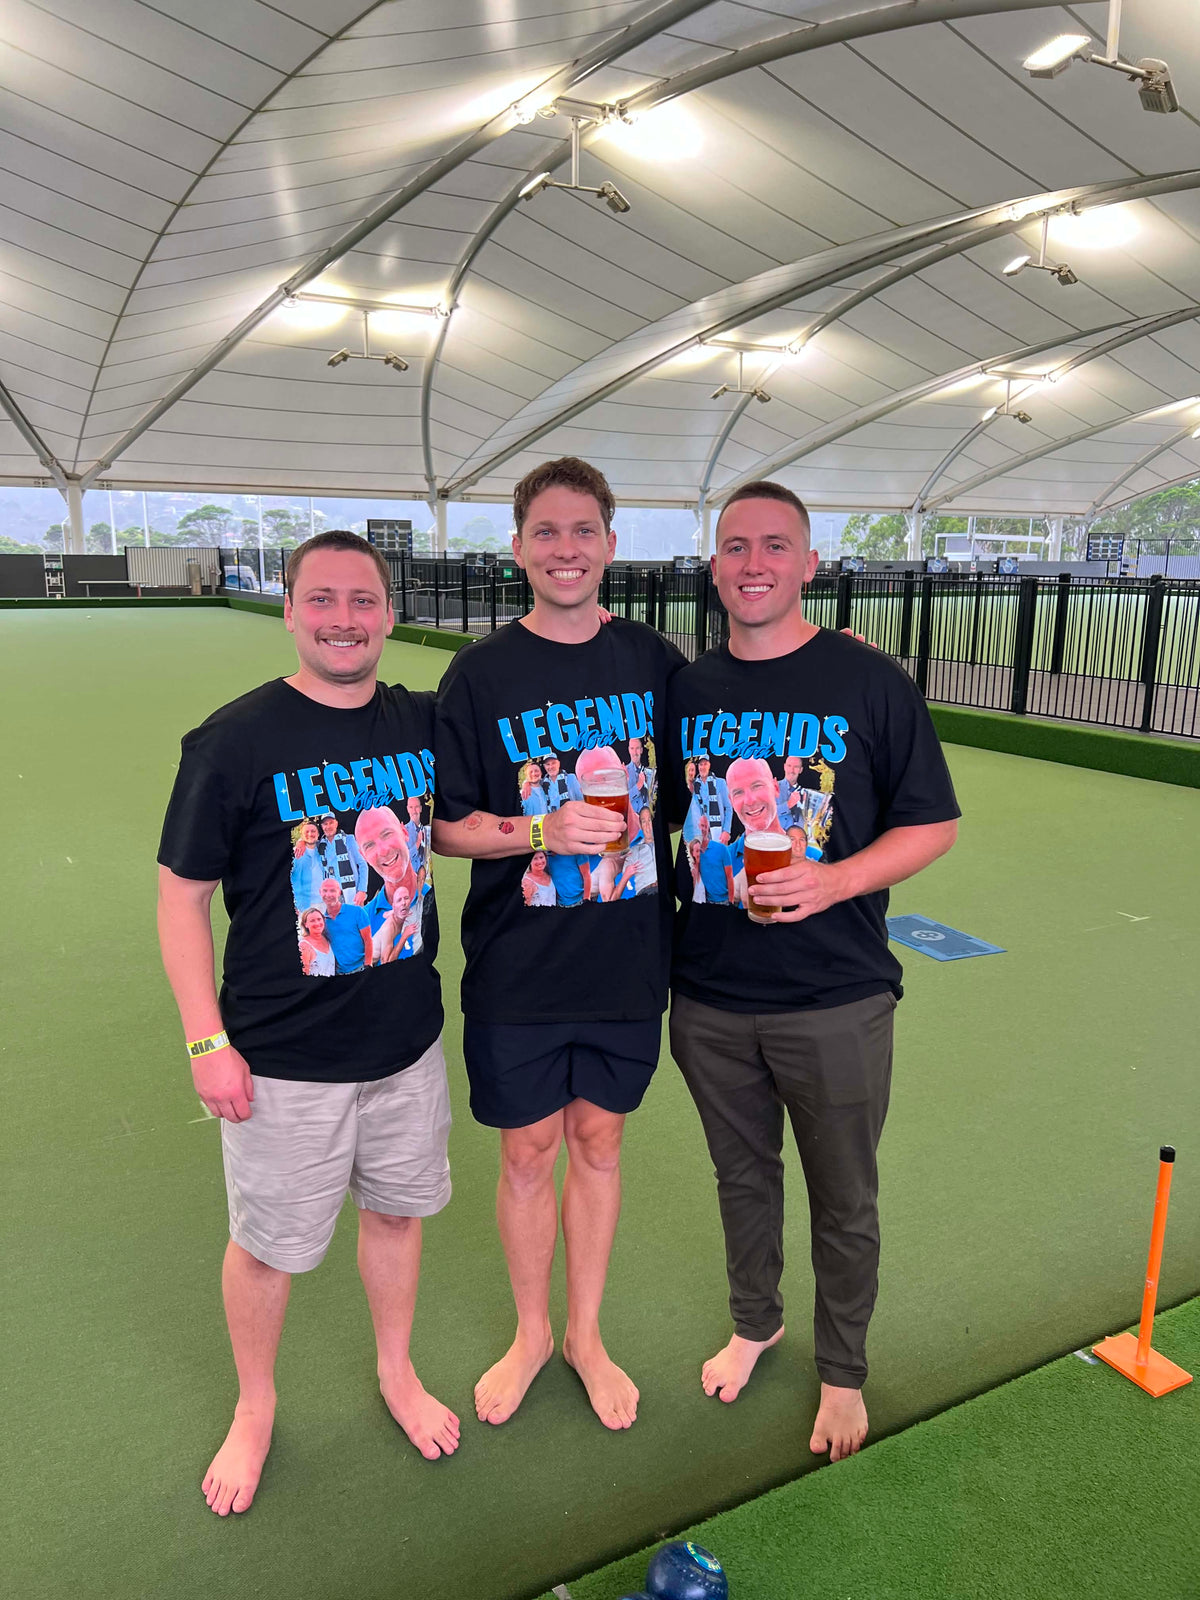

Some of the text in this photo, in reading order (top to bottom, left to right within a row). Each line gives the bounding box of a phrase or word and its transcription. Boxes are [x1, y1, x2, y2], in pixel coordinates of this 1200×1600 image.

[681, 711, 849, 763] LEGENDS
[273, 748, 436, 822] LEGENDS
[532, 823, 543, 848] VIP
[191, 1039, 215, 1055] VIP
